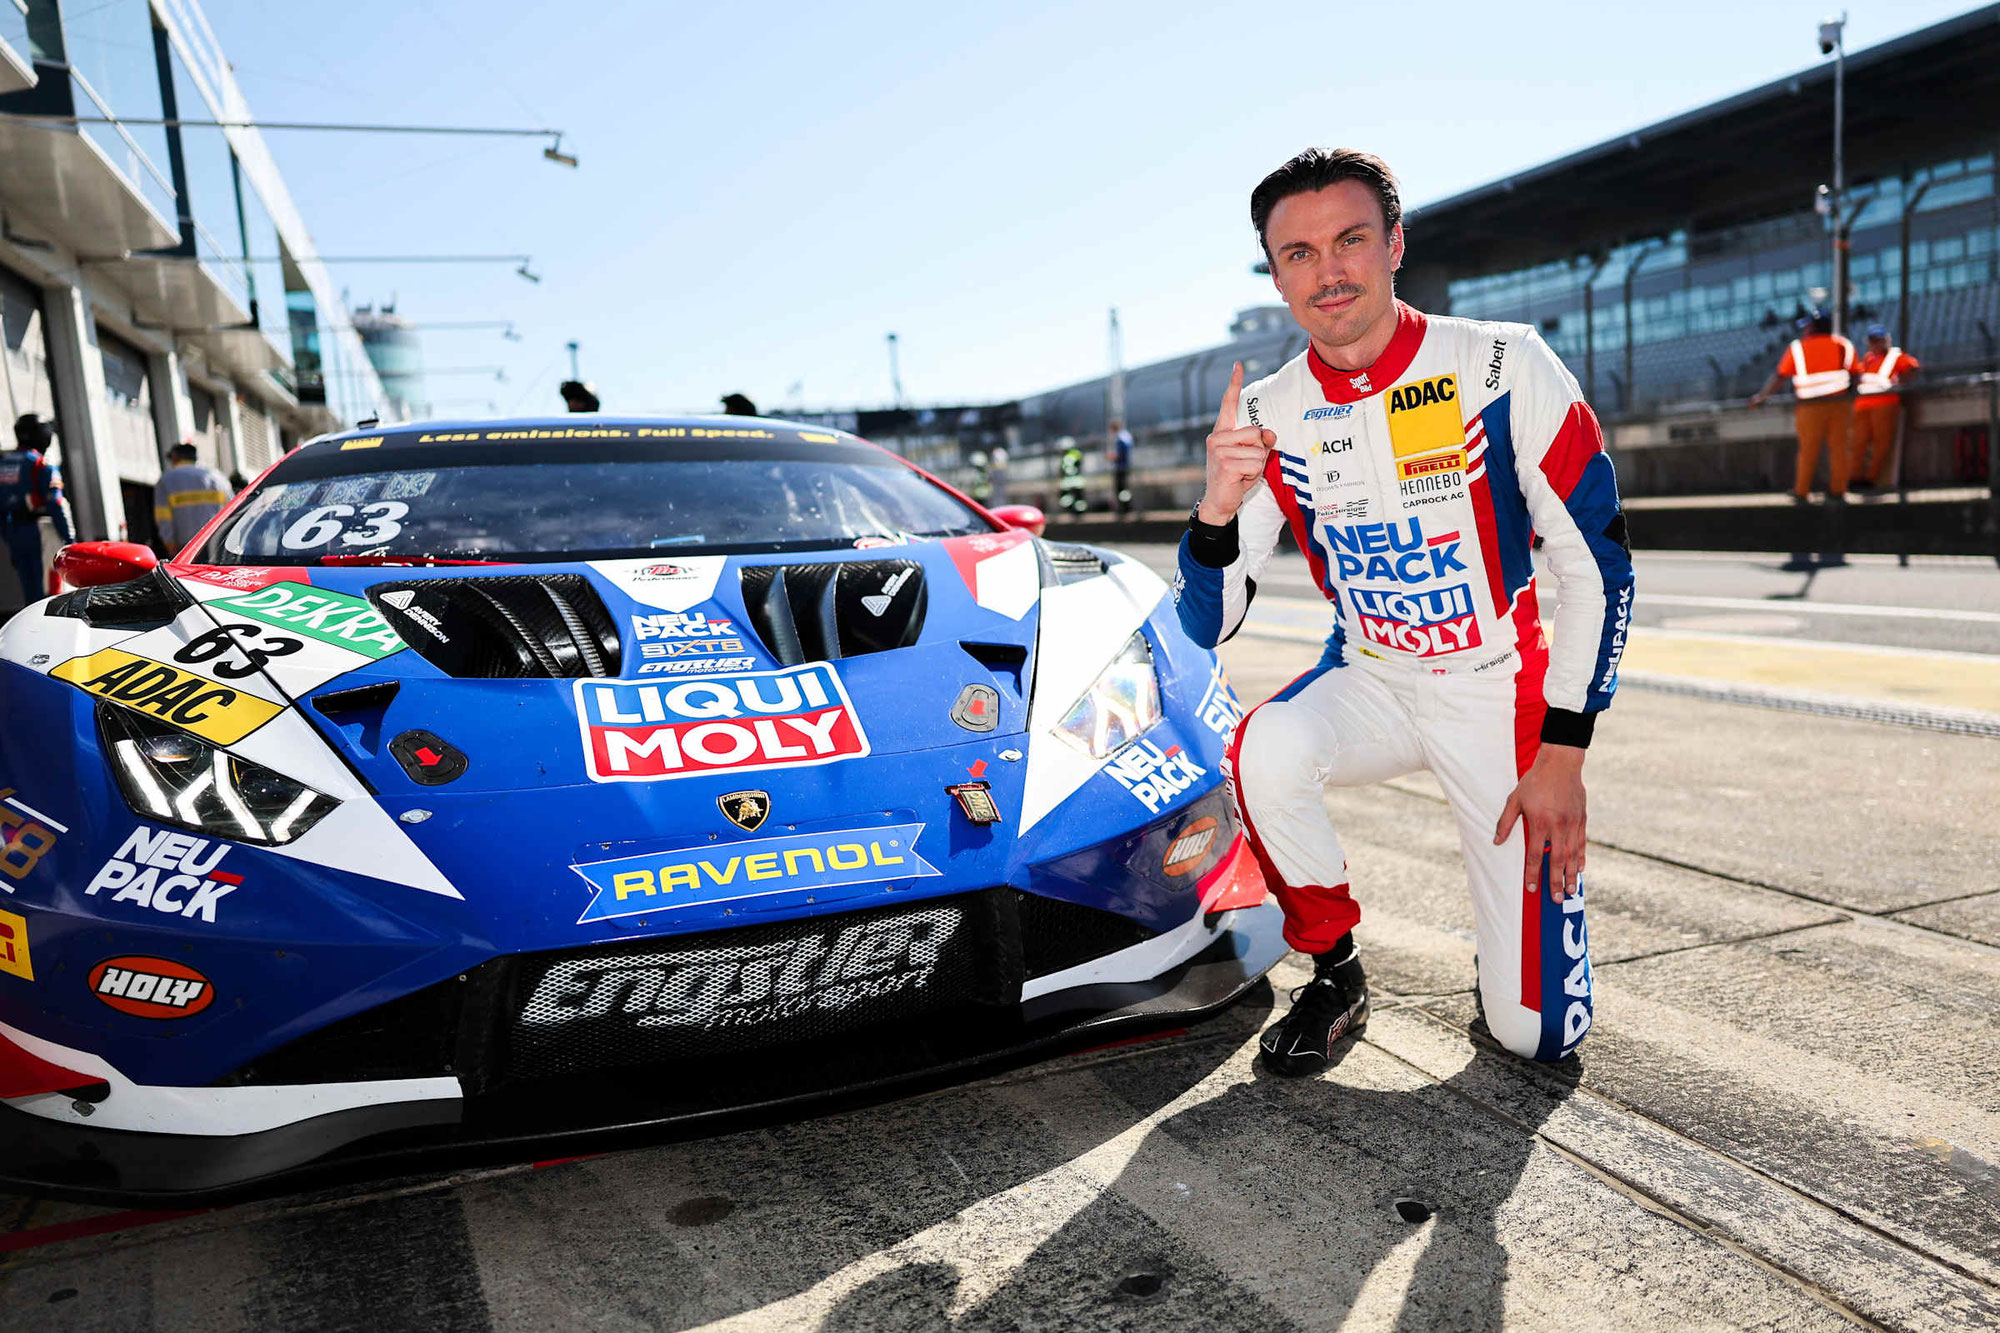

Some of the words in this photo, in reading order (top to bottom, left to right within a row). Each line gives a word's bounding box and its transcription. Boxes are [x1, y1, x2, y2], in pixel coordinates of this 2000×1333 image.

[1485, 339, 1507, 390] Sabelt
[1247, 397, 1263, 429] Sabe
[1390, 377, 1456, 413] ADAC
[419, 433, 480, 442] Less
[486, 428, 630, 440] emissions.
[638, 428, 686, 437] Full
[691, 429, 775, 439] Speed.
[1400, 472, 1461, 496] HENNEBO
[1404, 454, 1460, 476] PIRELLI
[1402, 496, 1448, 509] CAPROCK
[1450, 492, 1464, 502] AG
[282, 501, 409, 550] 63
[1323, 516, 1424, 554] NEU
[1335, 542, 1467, 584] PACK
[225, 587, 403, 652] DEKRA
[403, 608, 450, 643] DENNISON
[410, 606, 442, 626] AVERY
[631, 612, 706, 627] NEU
[1353, 587, 1468, 627] LIQUI
[174, 624, 303, 679] 63
[636, 622, 738, 641] PACK
[1363, 616, 1474, 655] MOLY
[1598, 585, 1632, 692] NEUPACK
[82, 660, 236, 724] ADAC
[595, 672, 830, 724] LIQUI
[603, 709, 844, 772] MOLY
[1103, 738, 1168, 789] NEU
[1130, 750, 1206, 814] PACK
[113, 826, 232, 876] NEU
[612, 841, 905, 901] RAVENOL
[84, 858, 238, 923] PACK
[99, 968, 204, 1008] HOLY
